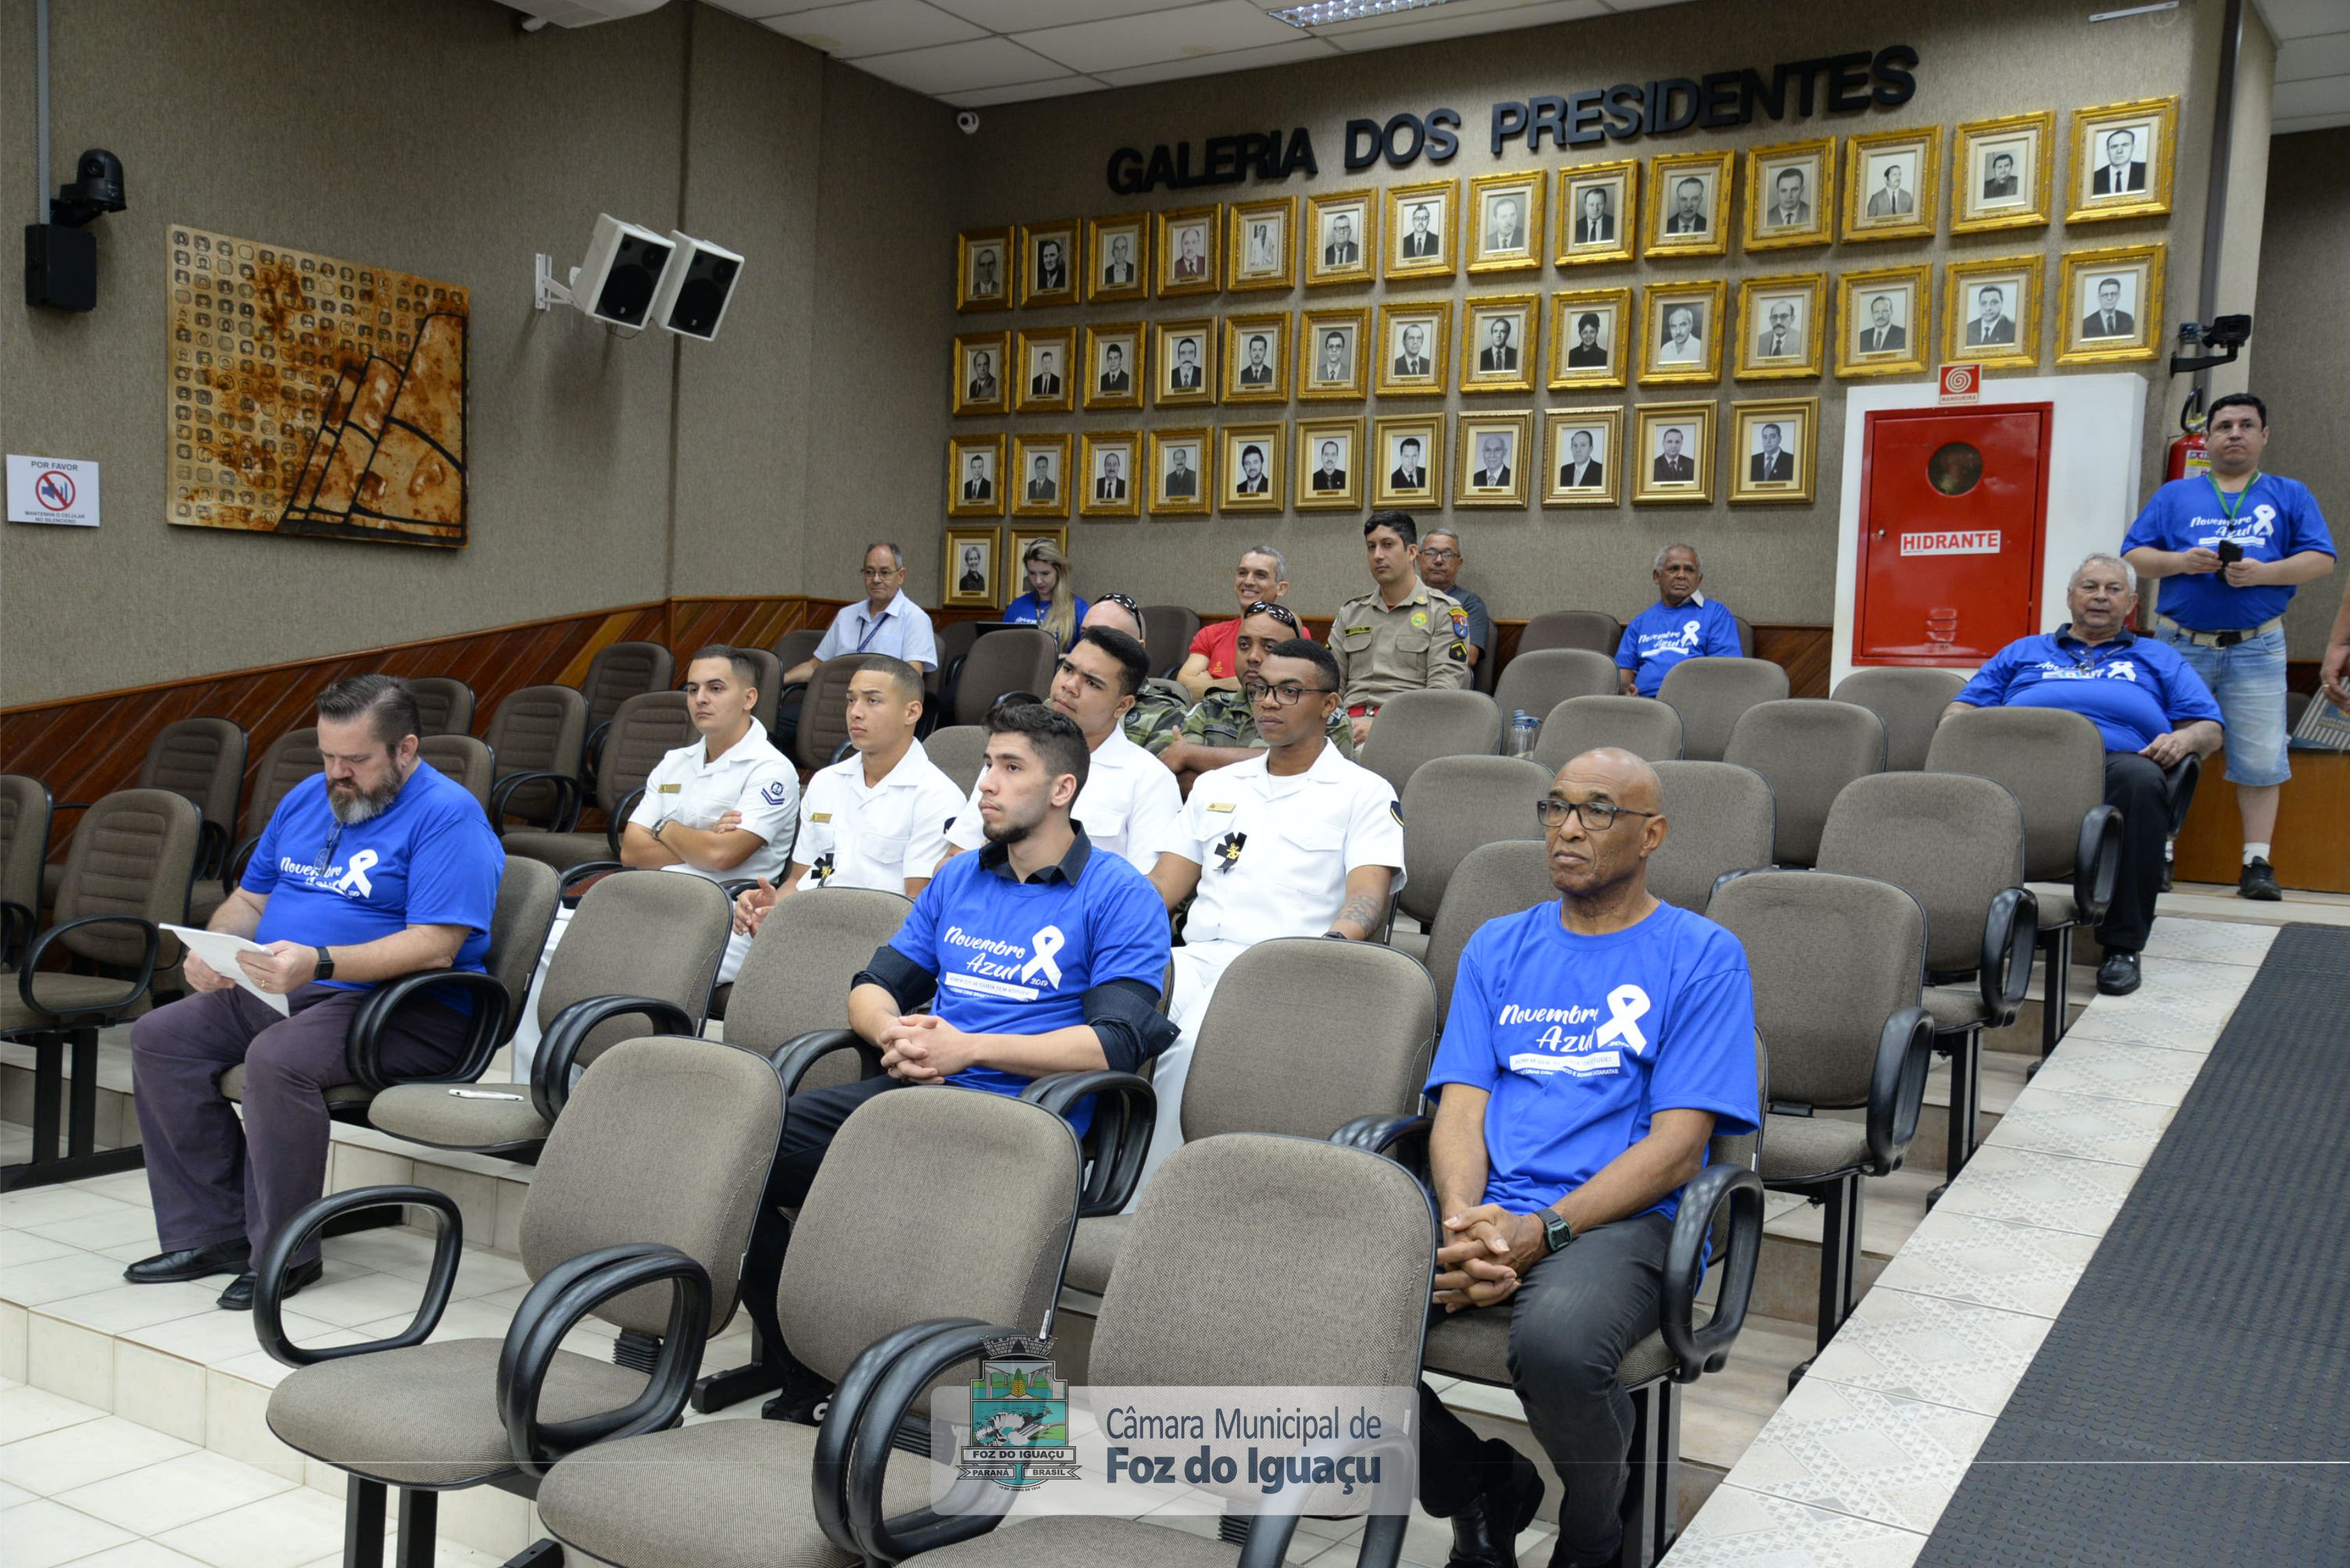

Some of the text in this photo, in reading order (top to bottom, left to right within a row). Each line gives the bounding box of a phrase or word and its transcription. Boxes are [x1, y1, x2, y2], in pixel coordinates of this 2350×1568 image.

[1107, 44, 1918, 194] GALERIA DOS PRESIDENTES
[51, 462, 78, 471] FAVOR
[1903, 533, 1999, 550] HIDRANTE
[944, 926, 1025, 959] Novembro
[966, 952, 1021, 981] Azul
